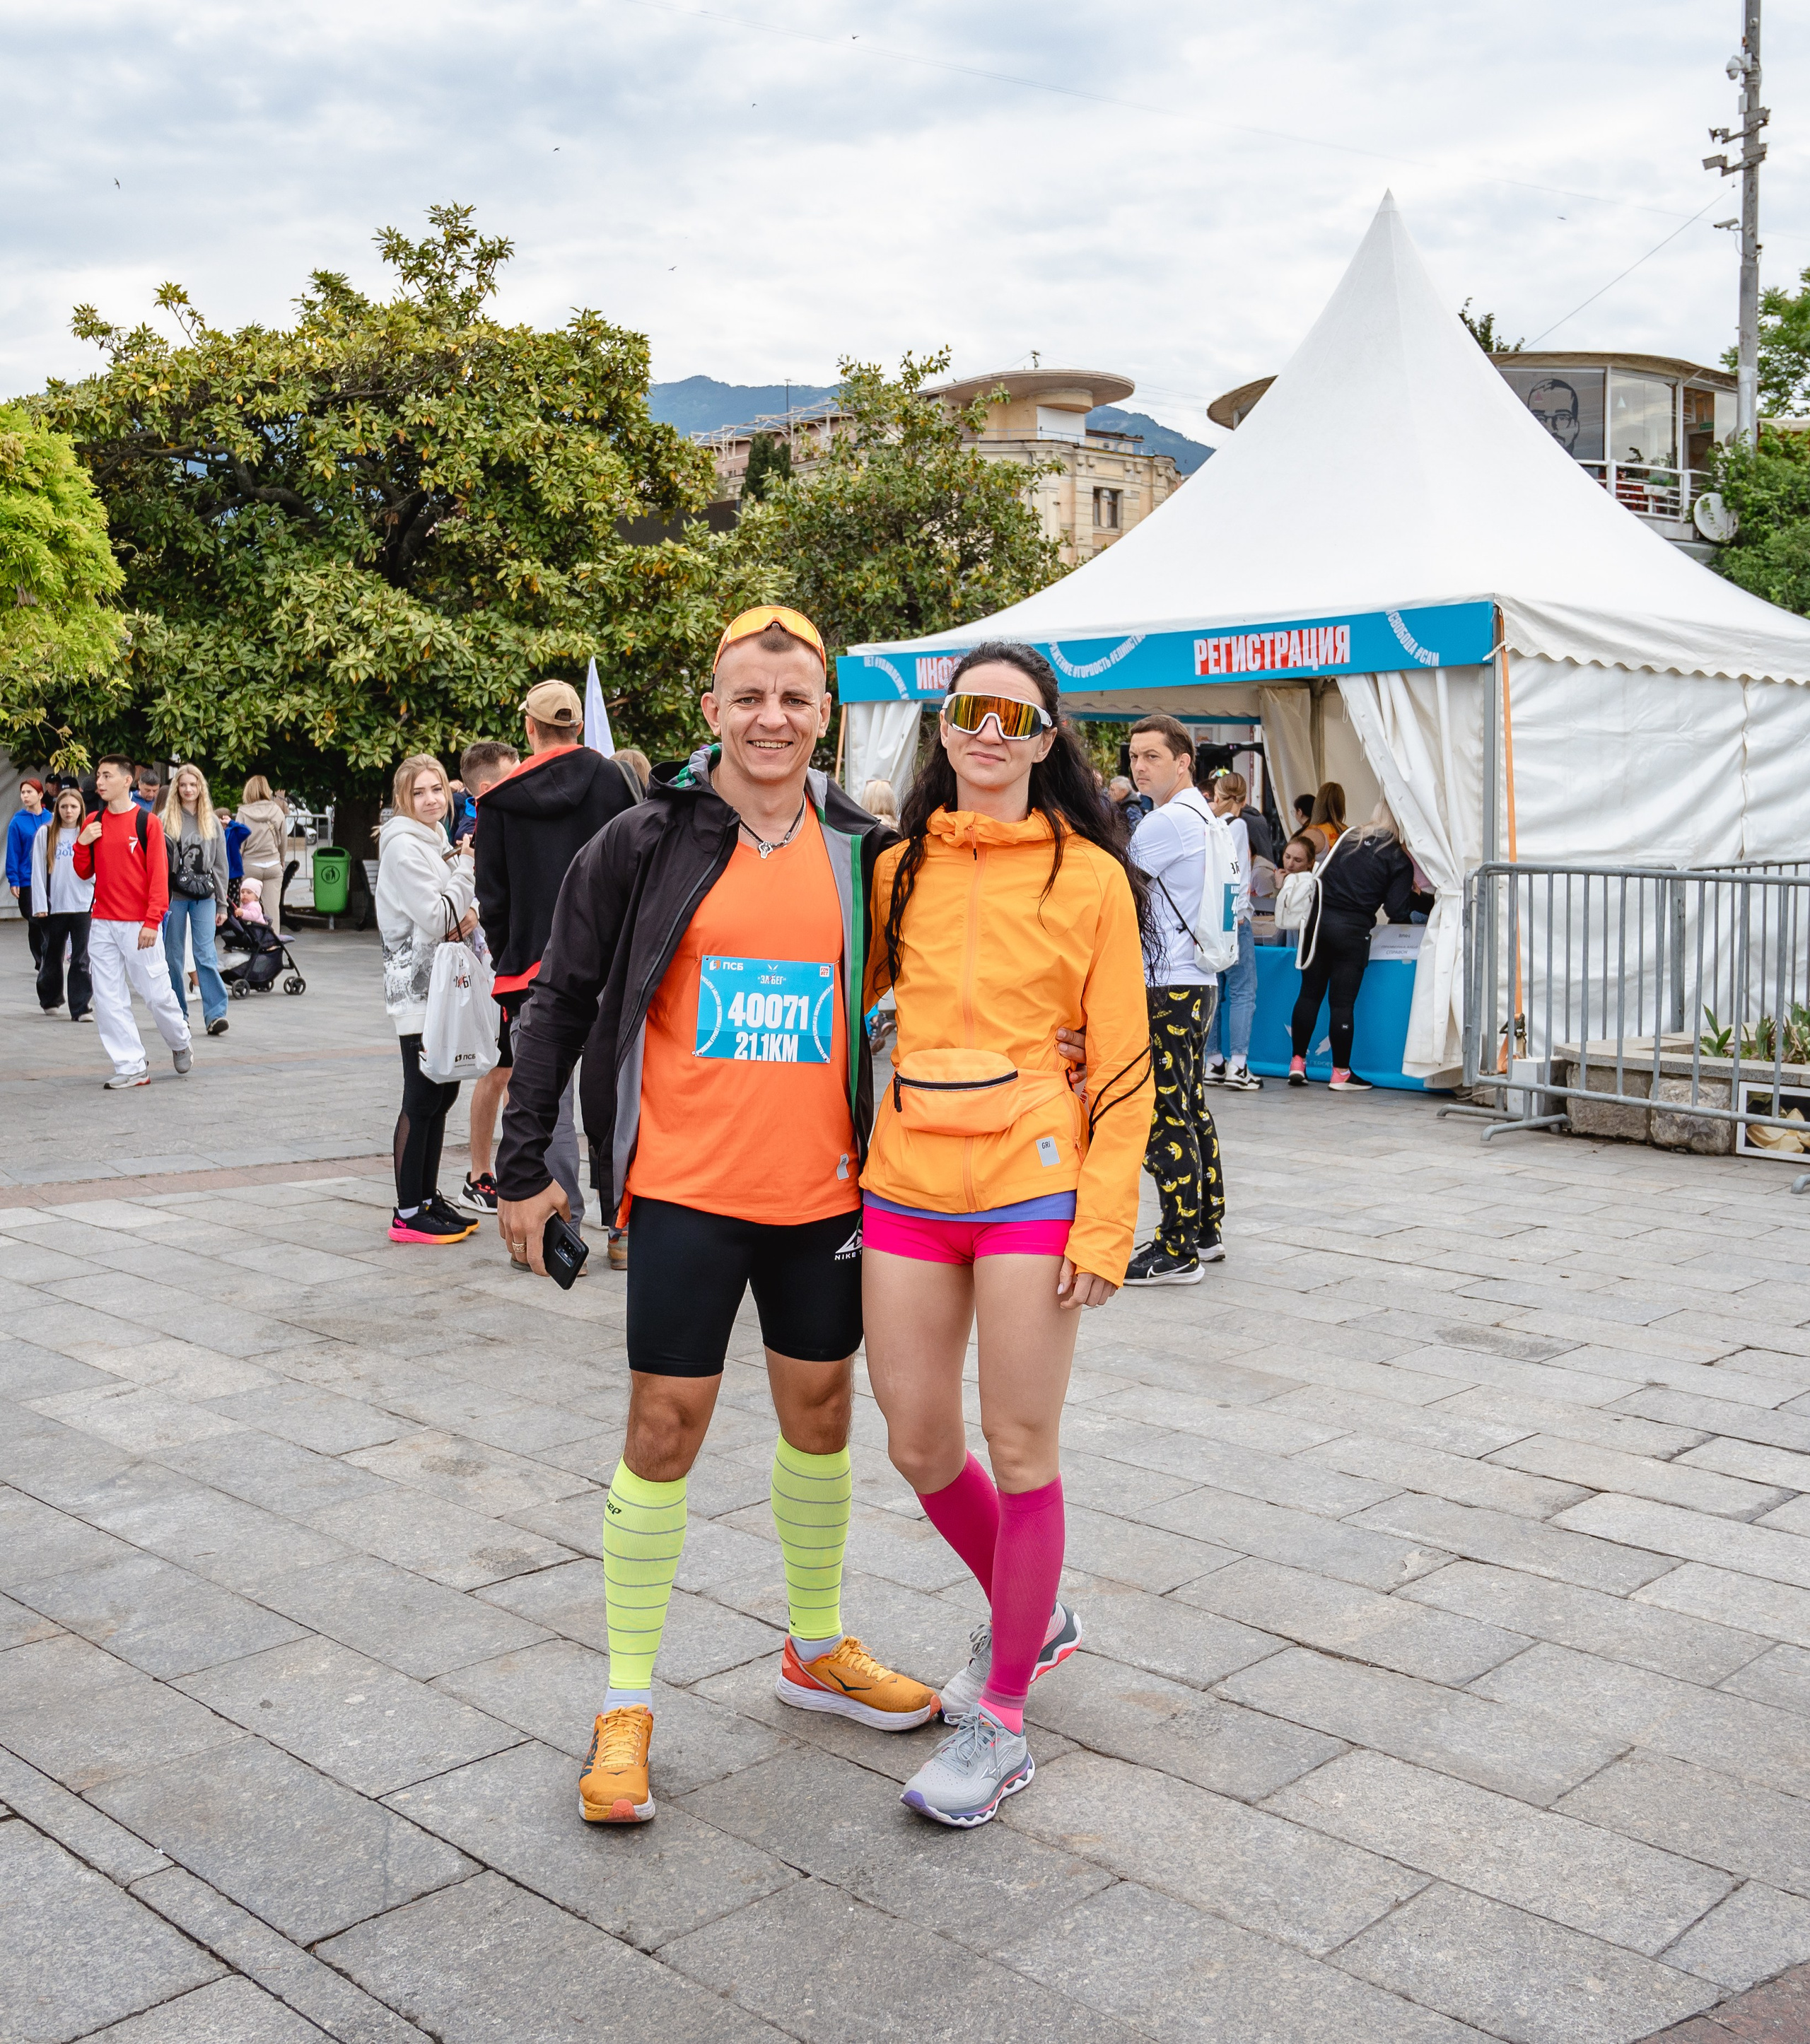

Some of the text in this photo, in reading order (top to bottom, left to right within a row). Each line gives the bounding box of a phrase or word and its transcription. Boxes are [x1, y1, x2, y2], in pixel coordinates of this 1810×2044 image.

[1193, 624, 1350, 676] РЕГИСТРАЦИЯ
[916, 657, 957, 690] ИНФ
[723, 961, 744, 971] ПСБ
[728, 991, 810, 1030] 40071
[834, 1251, 856, 1261] NIKE
